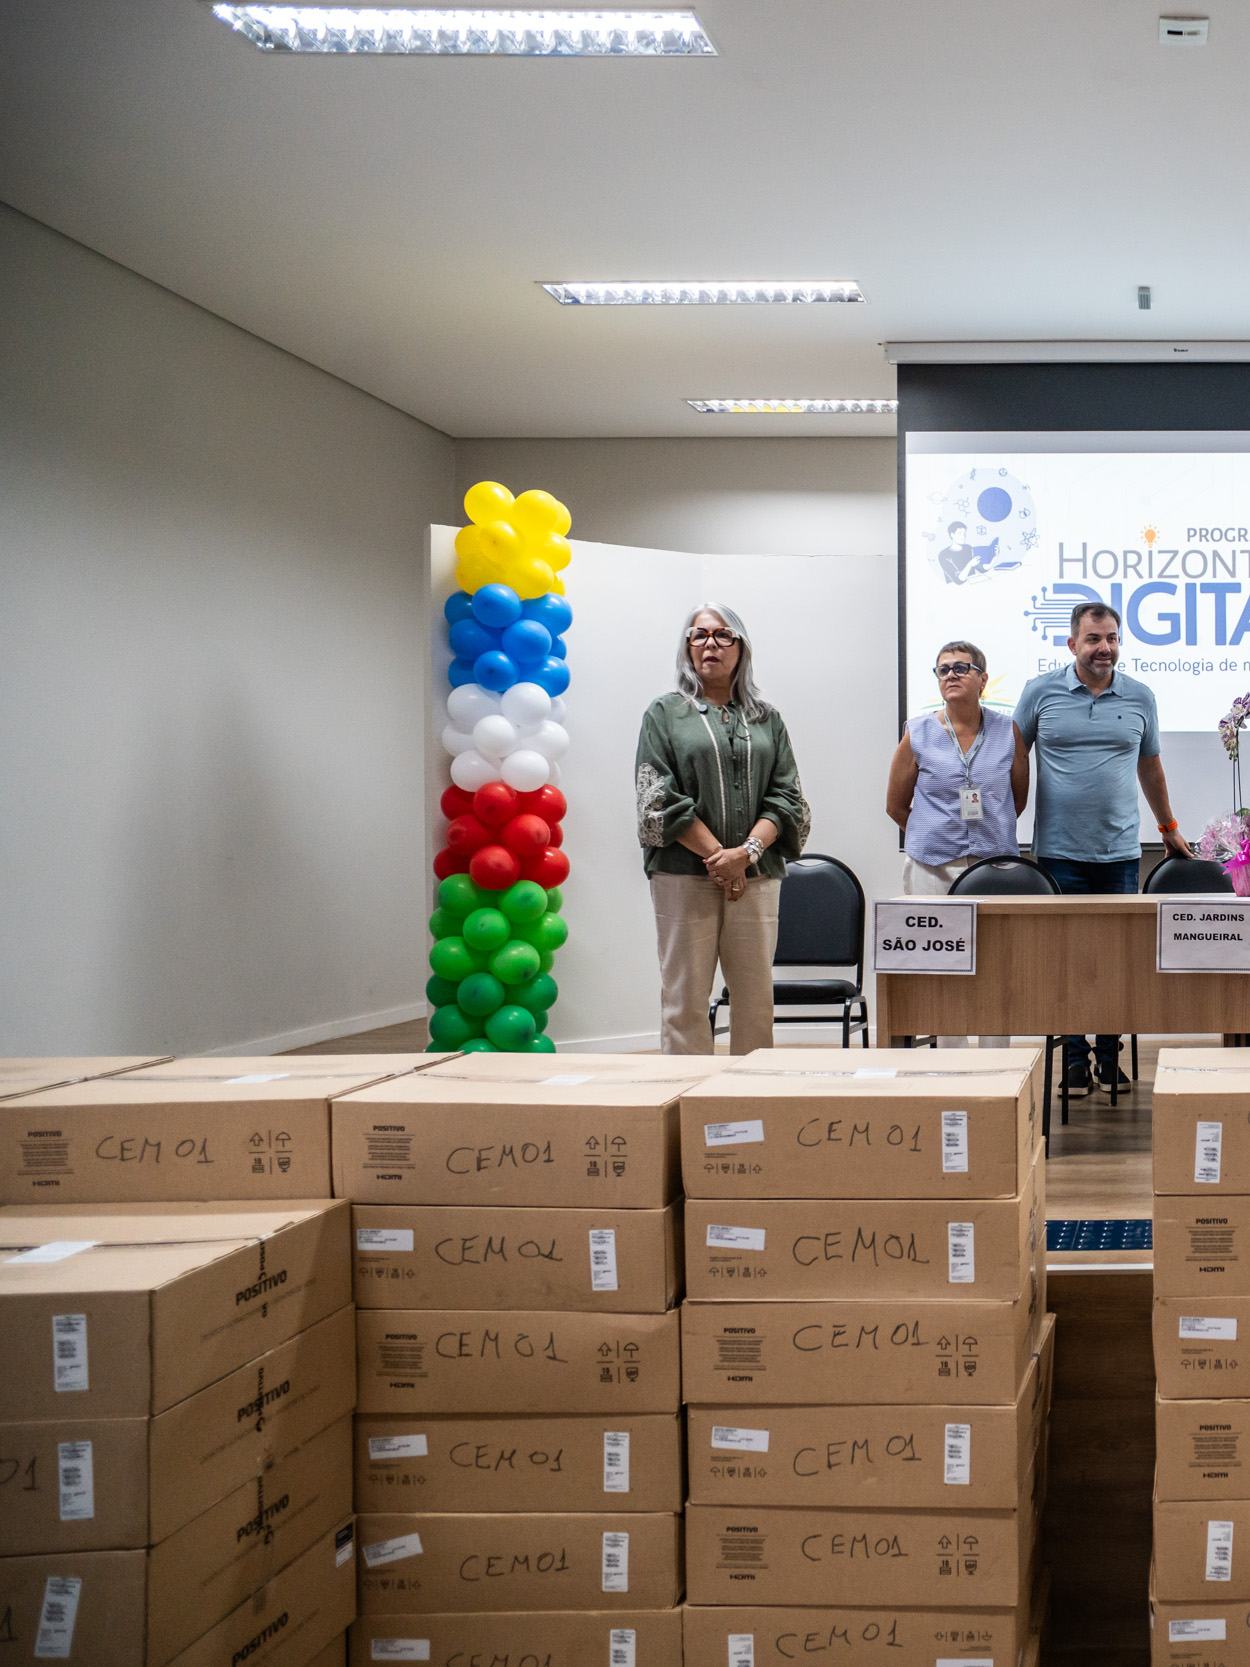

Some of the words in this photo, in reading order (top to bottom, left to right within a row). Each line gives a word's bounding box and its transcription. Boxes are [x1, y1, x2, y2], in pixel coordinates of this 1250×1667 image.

[1131, 658, 1214, 676] Tecnologia
[1219, 658, 1238, 672] de
[905, 916, 943, 928] CED.
[1172, 913, 1197, 922] CED.
[1199, 912, 1245, 922] JARDINS
[882, 937, 916, 951] SÃO
[922, 937, 966, 952] JOSÉ
[1173, 932, 1243, 942] MANGUEIRAL
[797, 1118, 871, 1147] CEM
[95, 1135, 162, 1164] CEM
[1195, 1217, 1228, 1225] POSITIVO
[236, 1269, 287, 1306] POSITIVO
[723, 1327, 756, 1335] POSITIVO
[793, 1439, 873, 1477] CEM
[232, 1612, 289, 1667] POSITIVO
